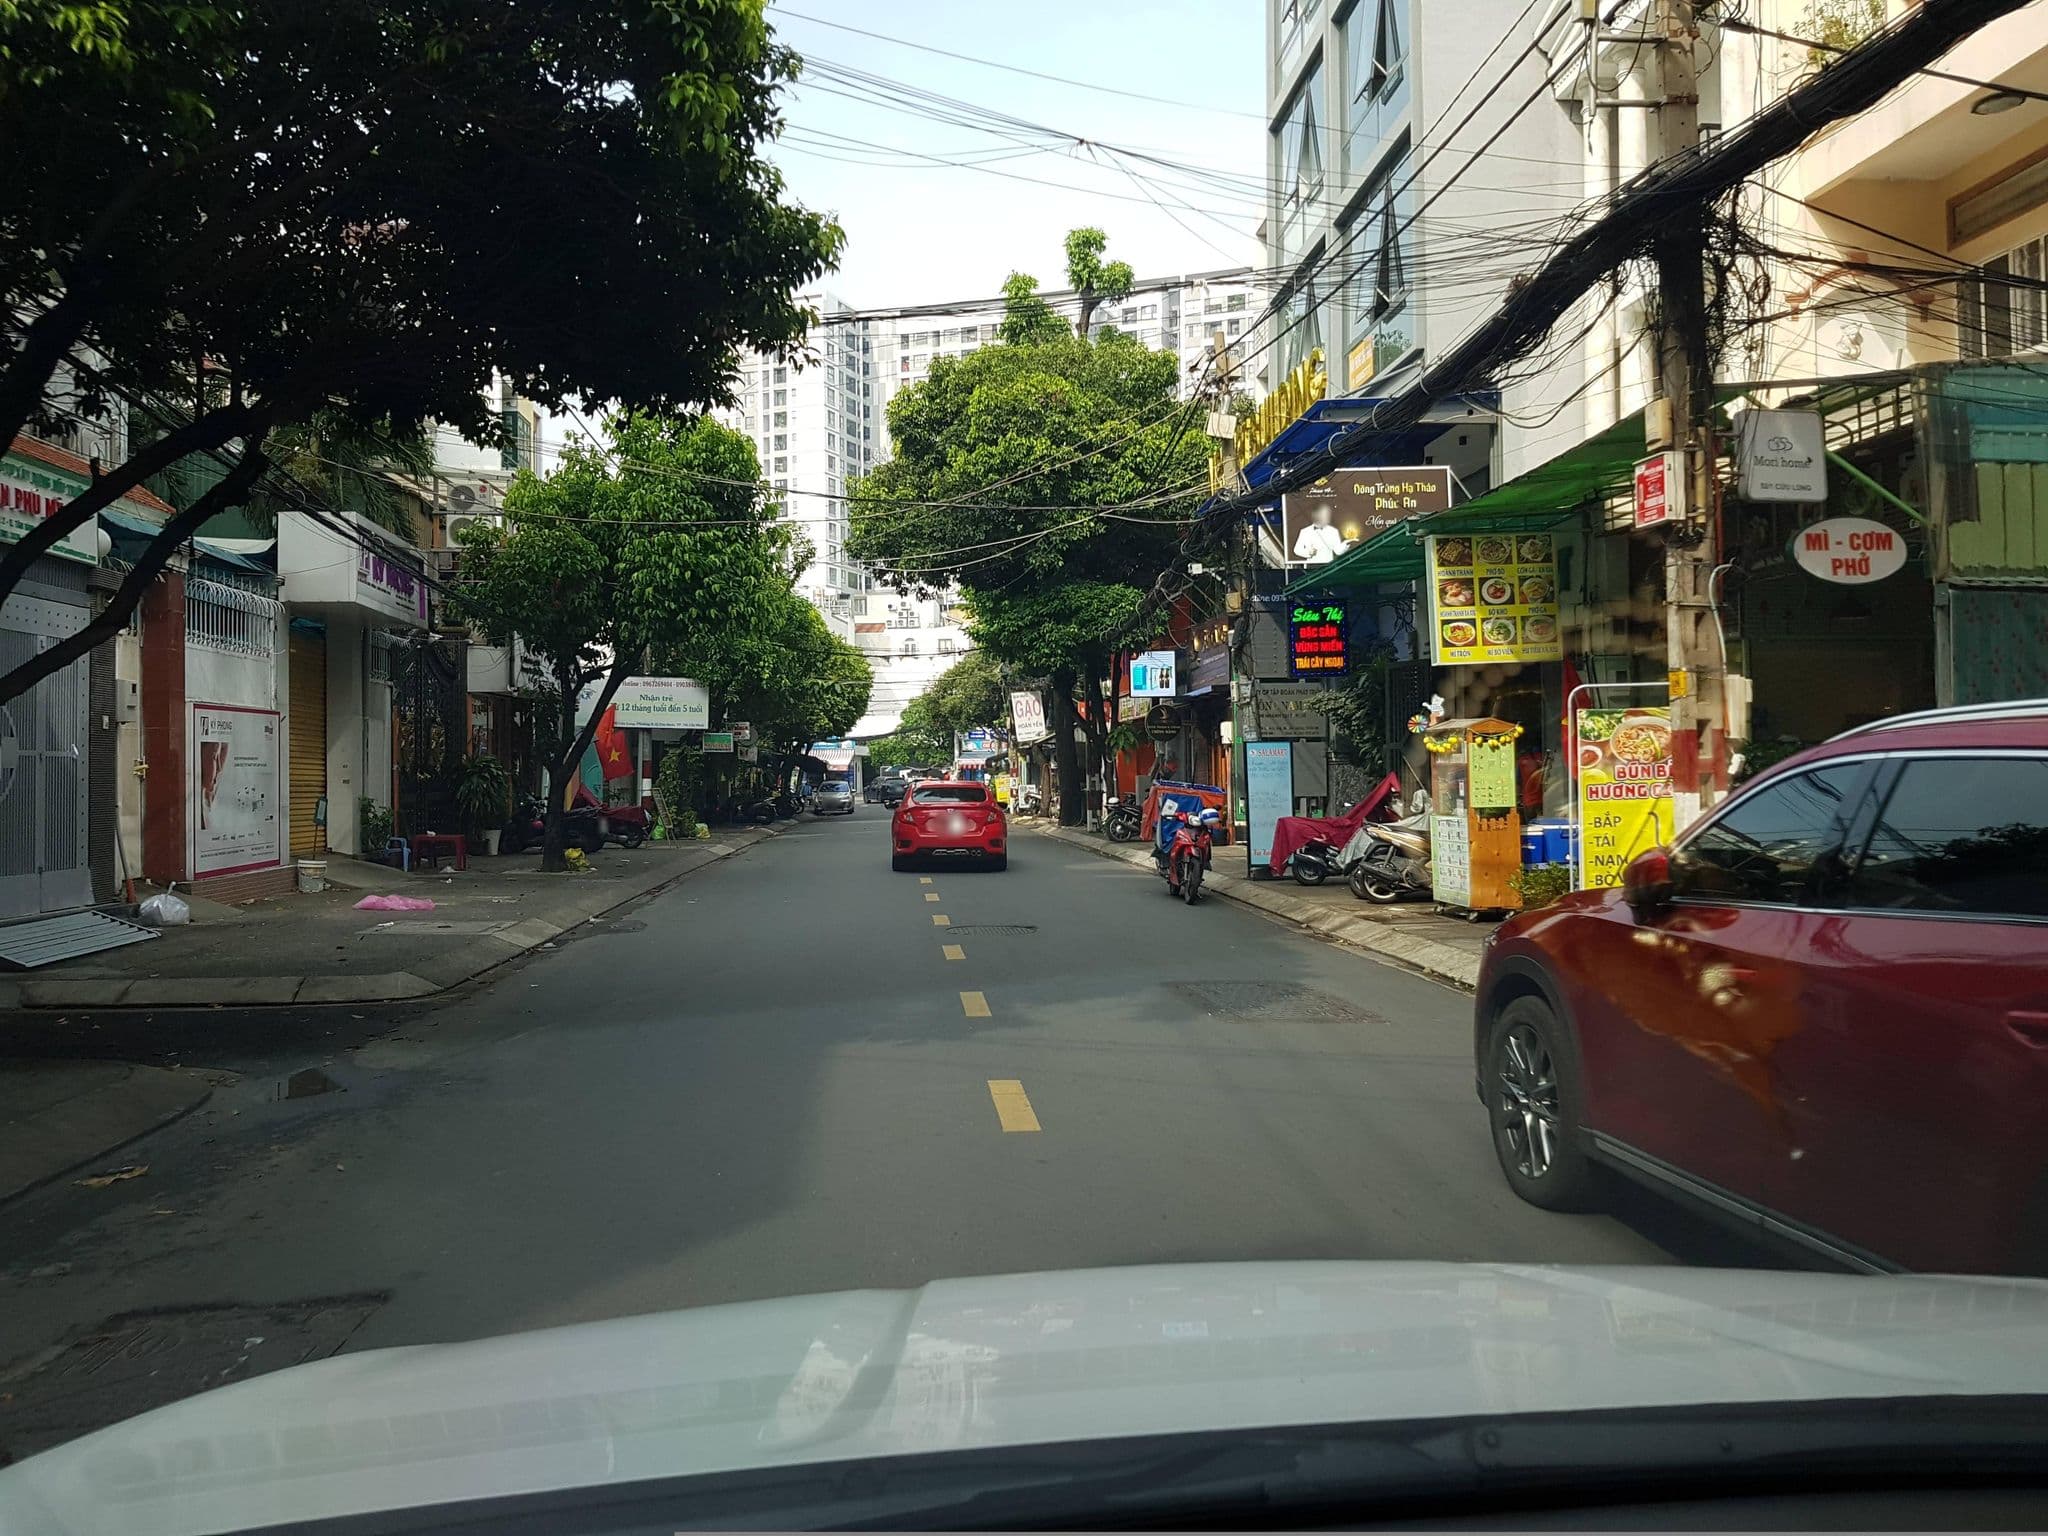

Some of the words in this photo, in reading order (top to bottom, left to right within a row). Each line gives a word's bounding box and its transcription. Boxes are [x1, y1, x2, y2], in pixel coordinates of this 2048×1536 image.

[1403, 496, 1417, 508] An
[1805, 529, 1830, 551] MÌ
[1849, 530, 1893, 551] CƠM
[1830, 551, 1871, 576] PHỞ
[1292, 607, 1320, 622] Siêu
[1322, 606, 1344, 624] Thị
[1295, 640, 1319, 653] VÙNG
[1295, 655, 1310, 669] TRÁI
[1310, 655, 1323, 668] CÂY
[639, 693, 661, 702] Nhận
[621, 703, 630, 711] 12
[631, 703, 652, 713] tháng
[653, 702, 667, 713] tuổi
[668, 702, 681, 712] đến
[682, 704, 688, 712] 5
[689, 703, 703, 713] tuổi
[1588, 783, 1649, 800] HƯƠNG
